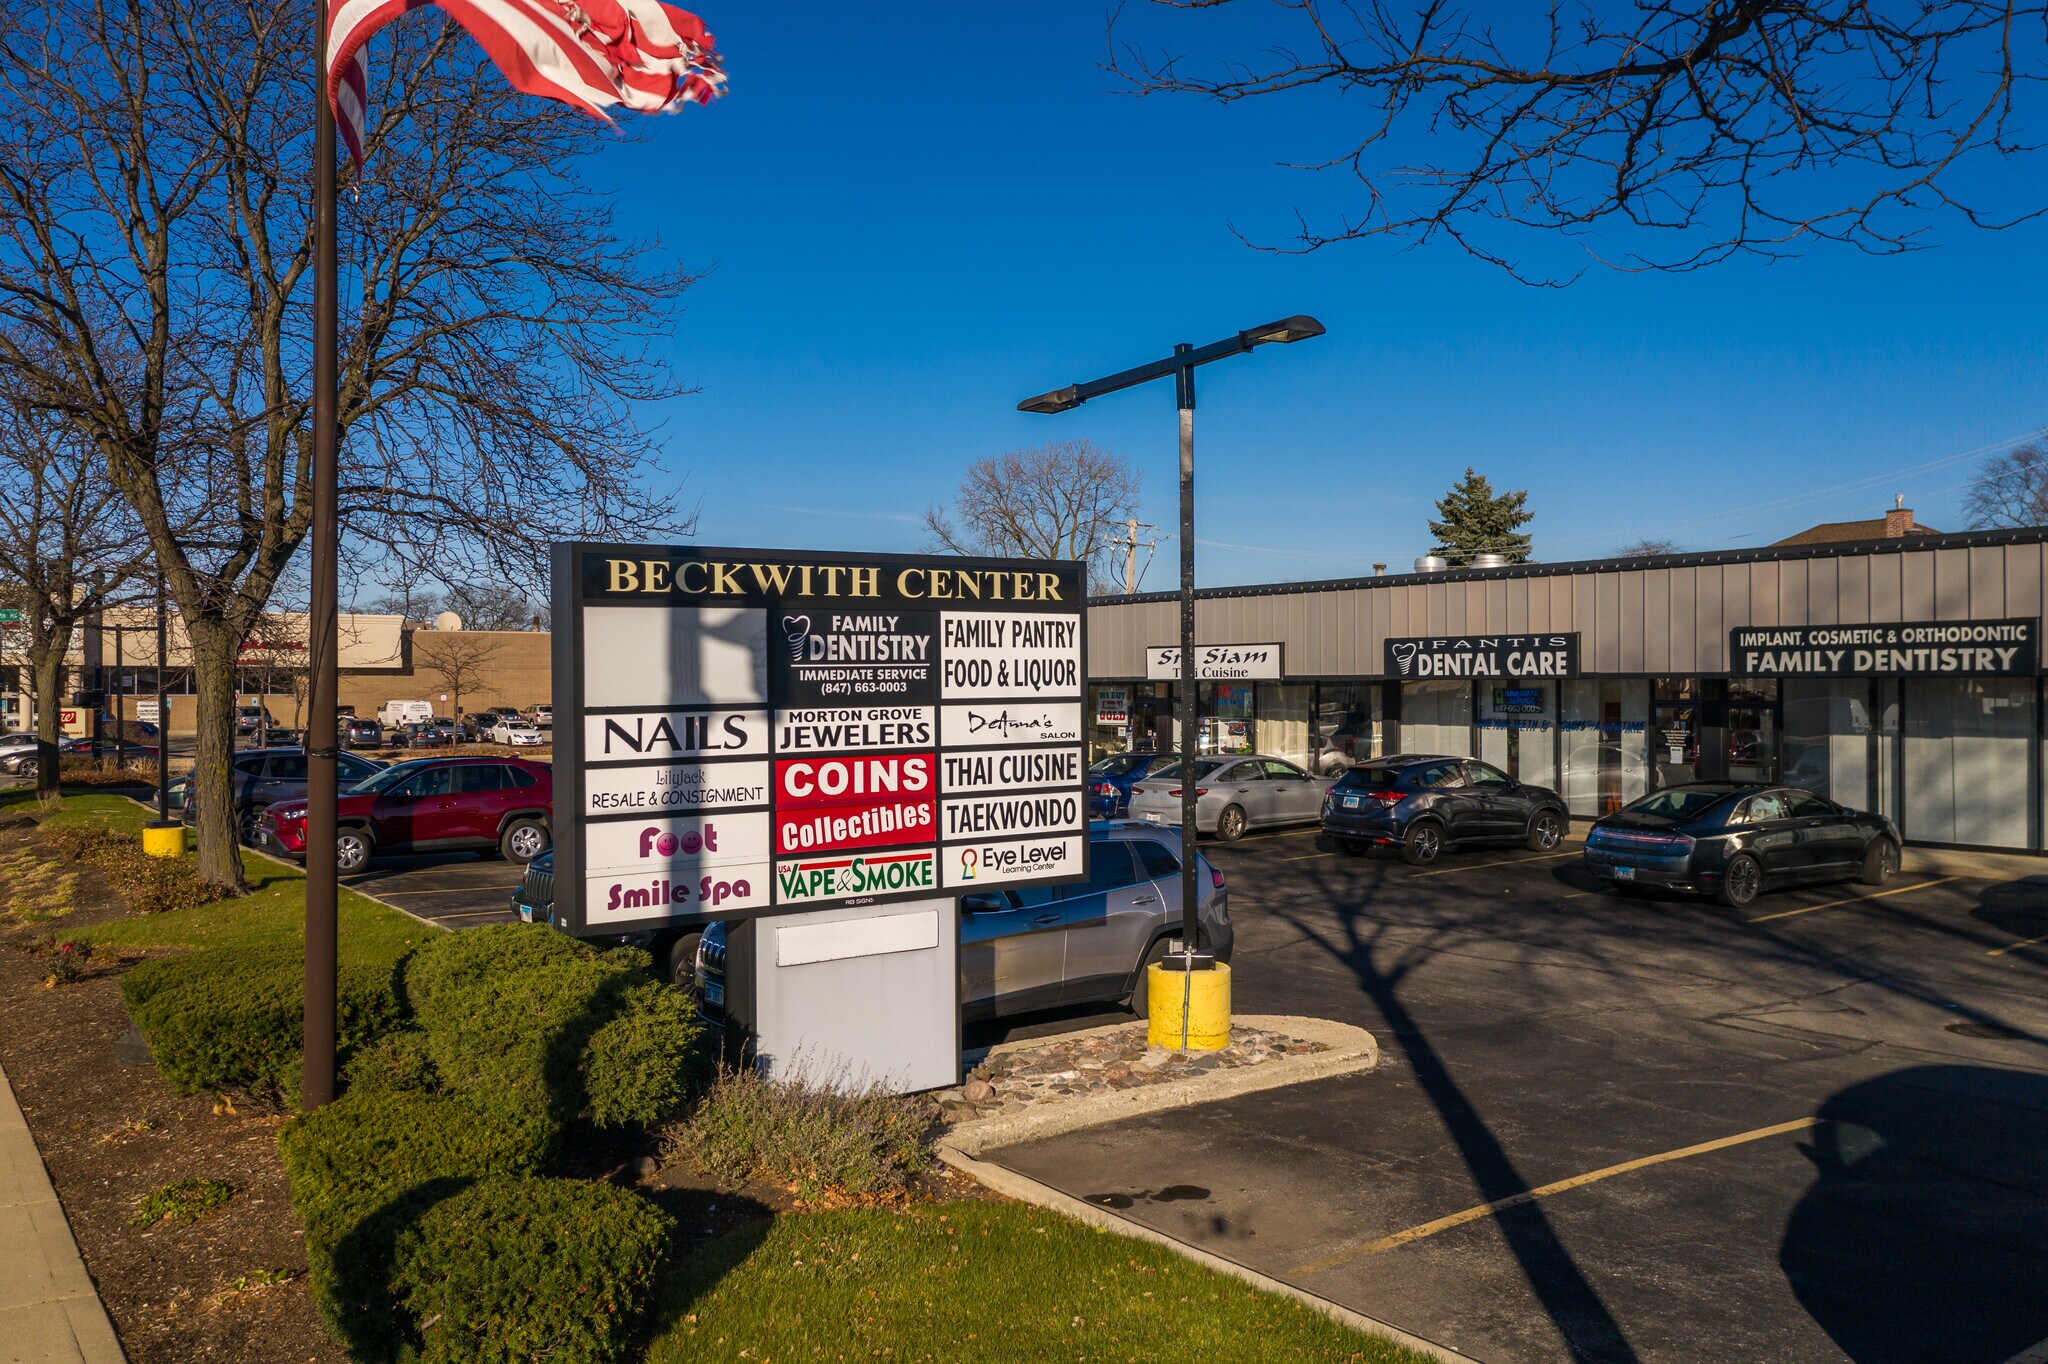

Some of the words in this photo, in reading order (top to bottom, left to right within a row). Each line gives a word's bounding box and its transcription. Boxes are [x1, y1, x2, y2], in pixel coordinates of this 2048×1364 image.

[605, 559, 881, 597] BECKWITH
[897, 568, 1063, 601] CENTER
[832, 615, 899, 632] FAMILY
[945, 619, 1006, 648] FAMILY
[1012, 620, 1076, 648] PANTRY
[1740, 631, 1804, 647] IMPLANT,
[1809, 629, 1883, 645] COSMETIC
[1887, 630, 1897, 644] &
[1902, 625, 2027, 643] ORTHODONTIC
[809, 634, 930, 661] DENTISTRY
[1157, 649, 1182, 665] Sr
[1203, 648, 1268, 665] Siam
[1418, 637, 1567, 650] IFANTIS
[1173, 667, 1198, 678] Ti
[1202, 667, 1249, 678] Cuisine
[1418, 652, 1500, 676] DENTAL
[1507, 651, 1567, 676] CARE
[1746, 650, 1845, 673] FAMILY
[1854, 647, 2018, 673] DENTISTRY
[799, 669, 873, 681] IMMEDIATE
[877, 668, 927, 680] SERVICE
[944, 659, 992, 688] FOOD
[997, 658, 1010, 687] &
[1014, 658, 1077, 692] LIQUOR
[821, 683, 851, 696] (847)
[854, 682, 907, 693] 663-0003
[789, 710, 862, 723] MORTON
[867, 708, 922, 721] GROVE
[968, 710, 1053, 738] DeAnna's
[1099, 711, 1126, 721] GOLD
[604, 714, 748, 754] NAILS
[780, 722, 930, 749] JEWELERS
[784, 758, 928, 797] COINS
[944, 756, 992, 786] THAI
[999, 753, 1077, 784] CUISINE
[592, 791, 645, 808] RESALE
[648, 791, 657, 806] &
[661, 787, 764, 805] CONSIGNMENT
[782, 803, 931, 851] Collectibles
[946, 797, 1077, 834] TAEKWONDO
[983, 847, 1017, 870] Eye
[1021, 841, 1066, 864] Level
[1002, 864, 1032, 874] Learning
[1033, 863, 1055, 871] Center
[778, 865, 792, 873] USA
[779, 863, 836, 899] VAPE
[852, 857, 933, 893] SMOKE
[607, 879, 691, 911] Smile
[698, 876, 751, 906] Spa
